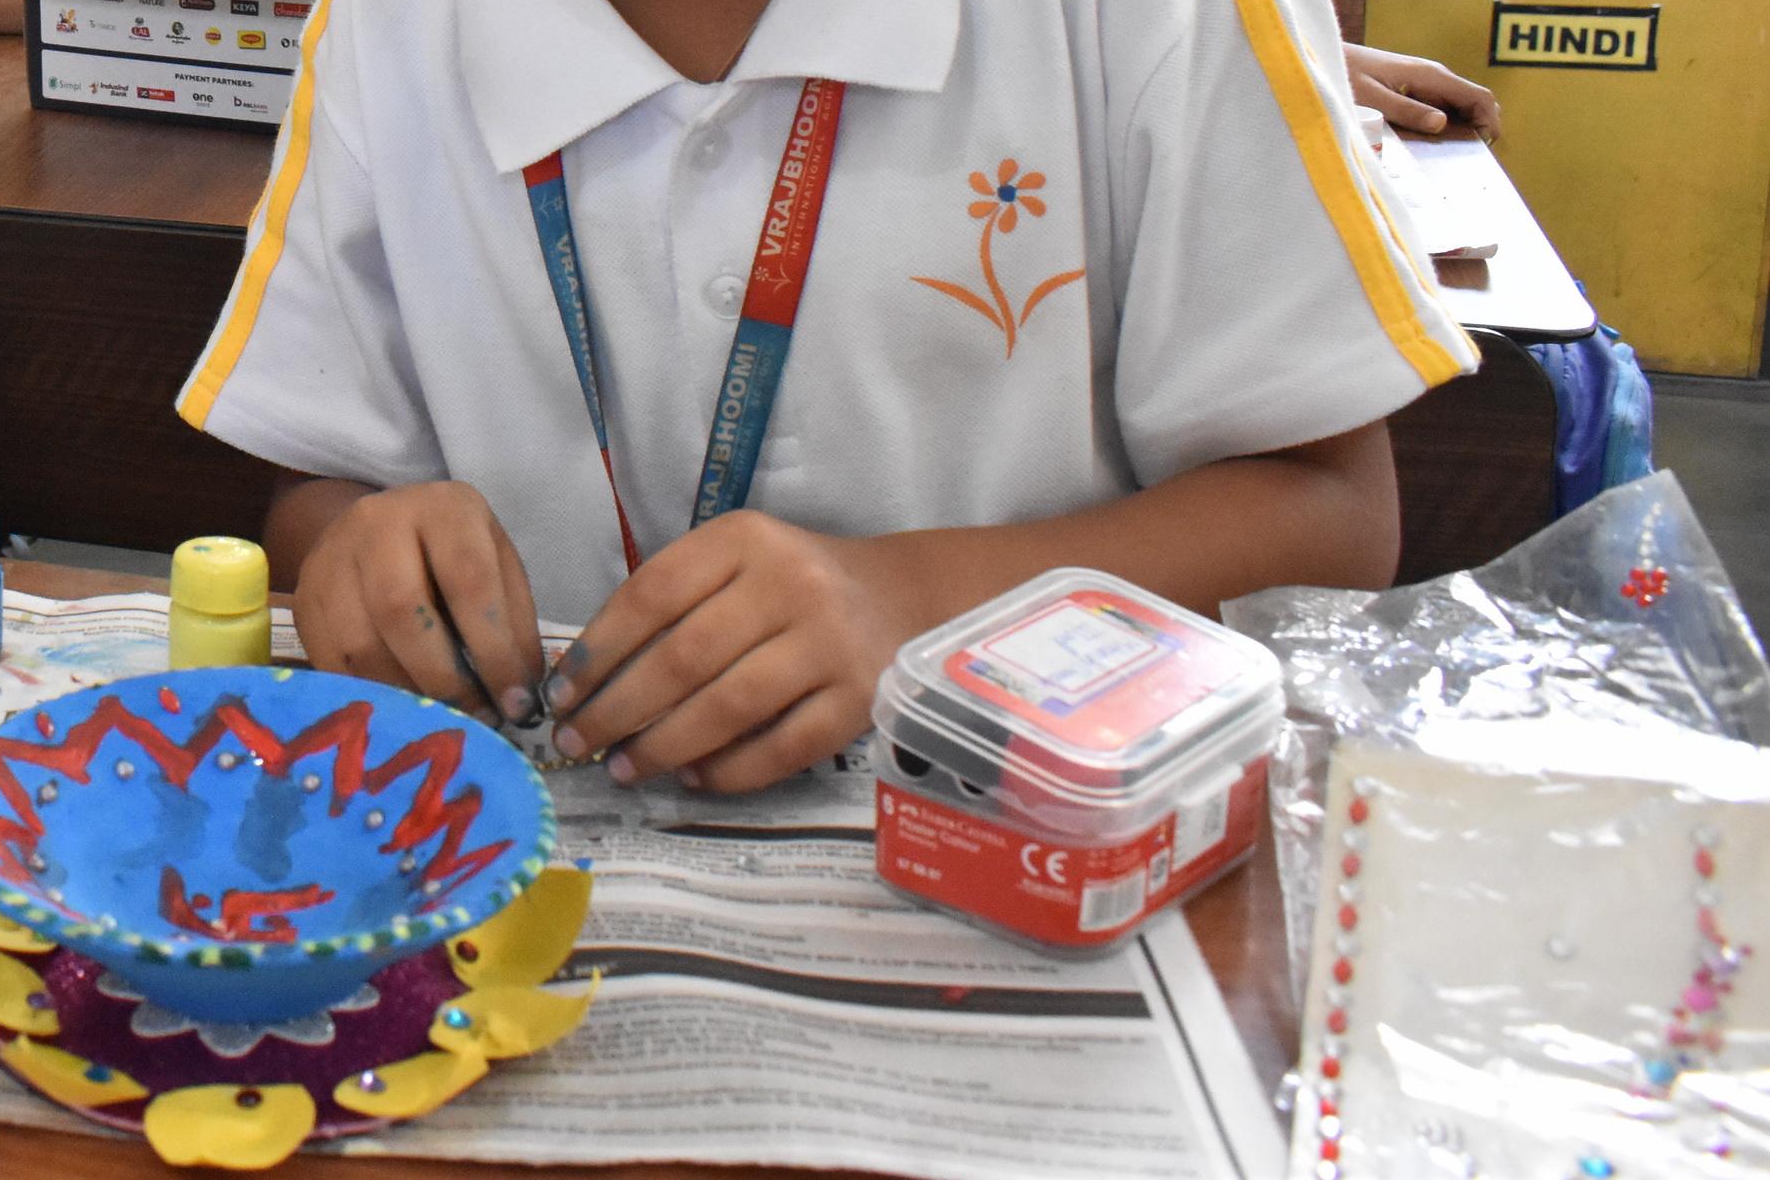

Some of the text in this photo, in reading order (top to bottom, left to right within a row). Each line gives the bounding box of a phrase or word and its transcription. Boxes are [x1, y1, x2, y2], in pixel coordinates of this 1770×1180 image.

[1508, 23, 1636, 58] HINDI
[174, 73, 255, 88] PAYMENT PARTNERS:
[790, 135, 825, 256] INTERNATIONAL
